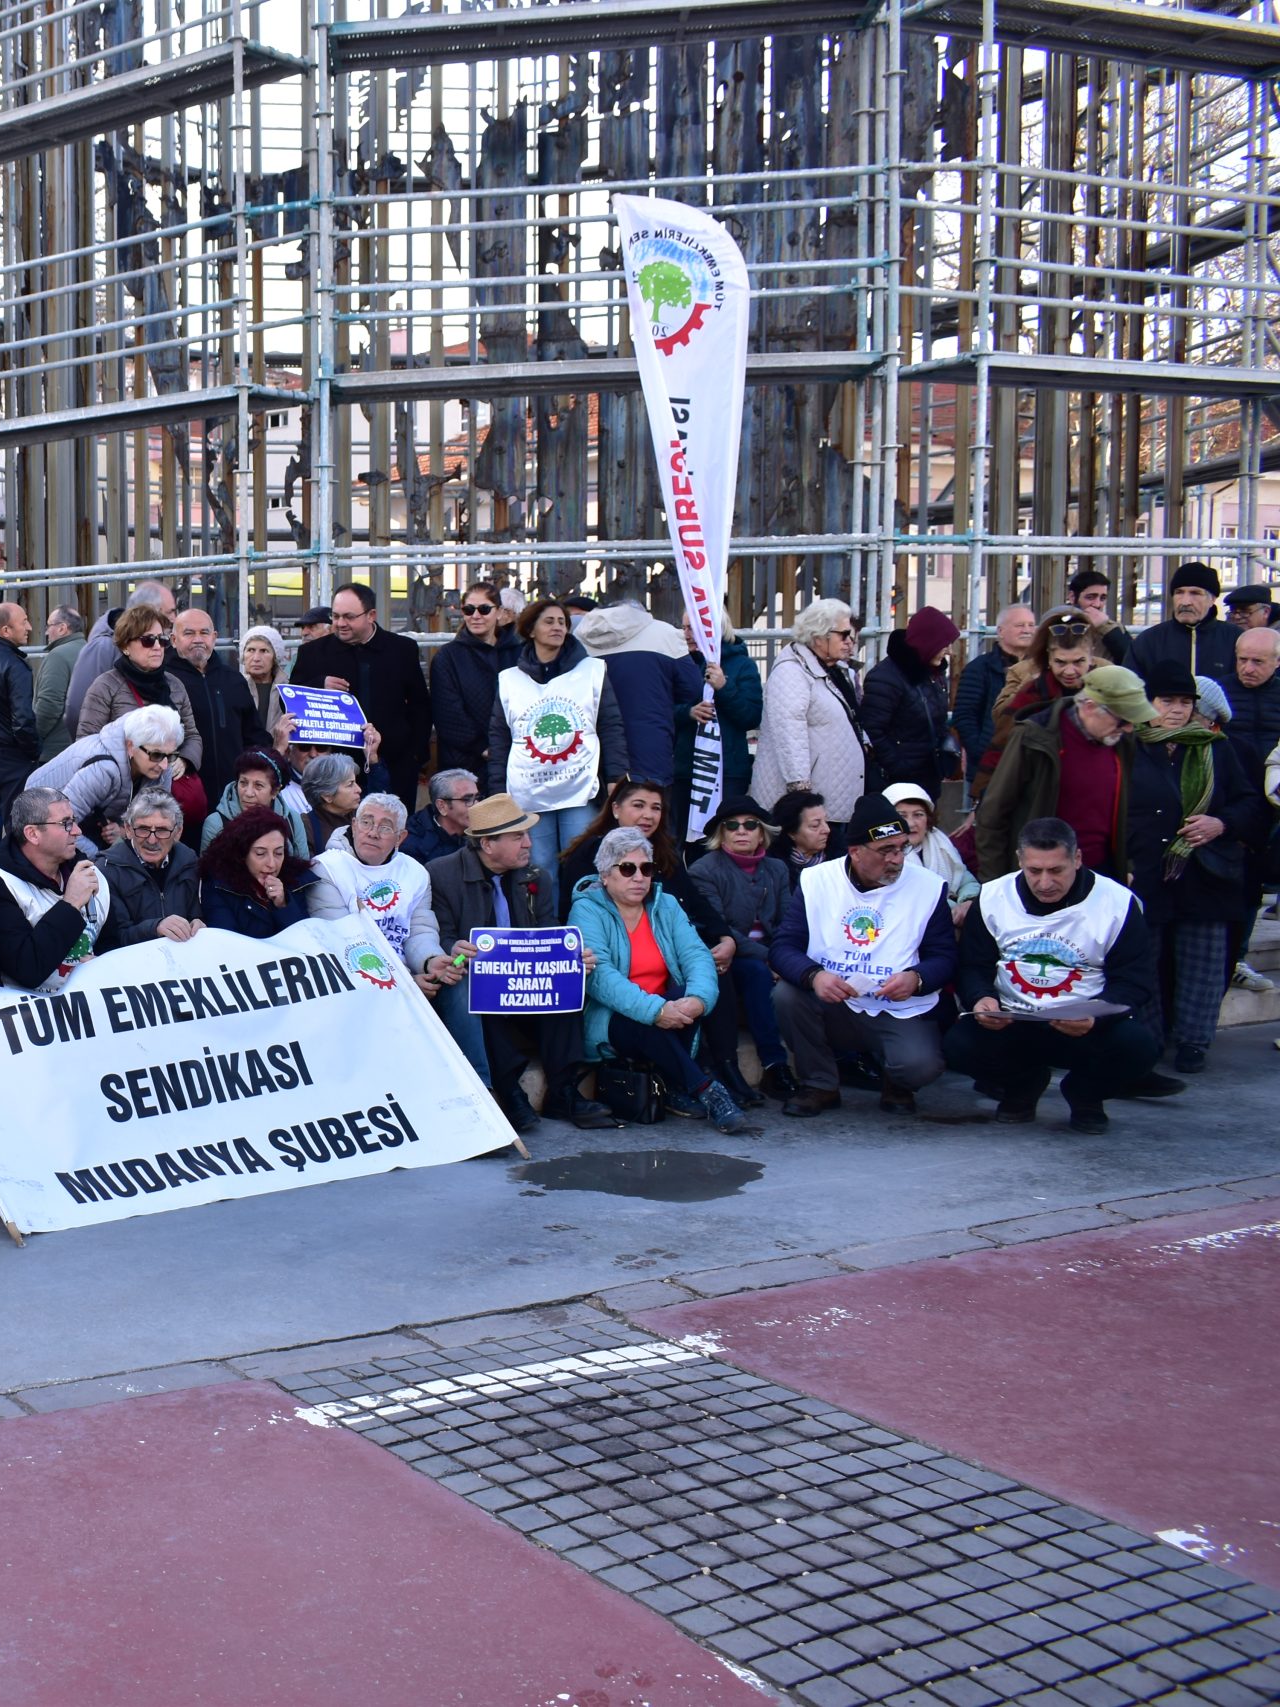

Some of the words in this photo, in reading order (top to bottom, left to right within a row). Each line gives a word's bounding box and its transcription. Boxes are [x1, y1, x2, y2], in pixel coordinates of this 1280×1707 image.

[295, 718, 325, 729] EFALETLE
[844, 950, 871, 961] TÜM
[474, 959, 532, 975] EMEKLİYE
[535, 960, 581, 976] KAŞIKLA,
[820, 957, 893, 976] EMEKLİLER
[507, 977, 553, 991] SARAYA
[1031, 977, 1050, 986] 2017
[107, 953, 356, 1034] EMEKLİLERİN
[500, 993, 553, 1006] KAZANLA
[555, 992, 560, 1006] !
[100, 1041, 314, 1123] SENDİKASI
[55, 1137, 275, 1205] MUDANYA
[267, 1092, 420, 1173] ŞUBESİ
